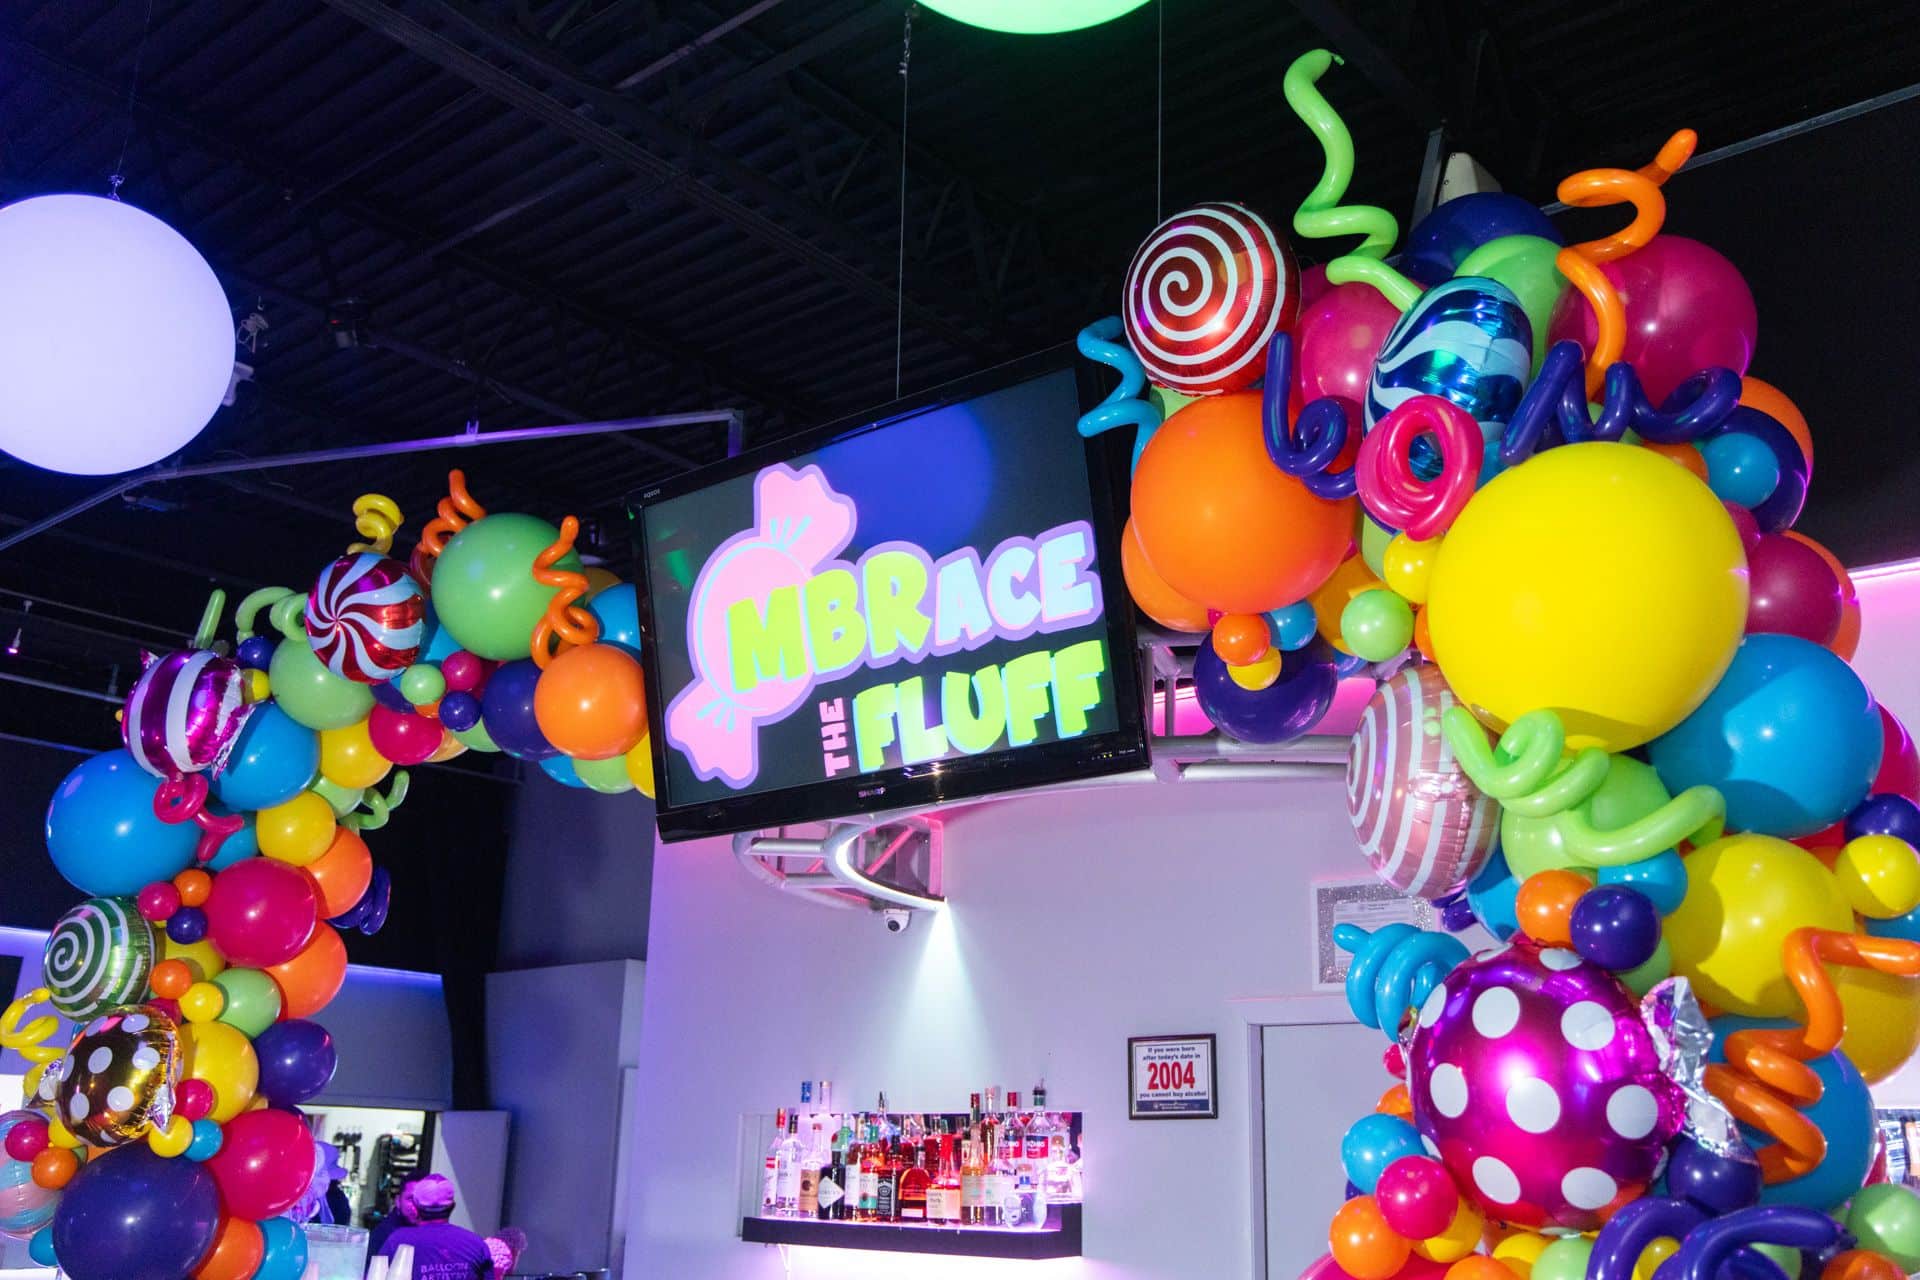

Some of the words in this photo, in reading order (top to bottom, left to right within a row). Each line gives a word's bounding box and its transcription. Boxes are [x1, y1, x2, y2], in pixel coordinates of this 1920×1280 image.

[726, 531, 1095, 695] MBRACE
[819, 697, 851, 778] THE
[852, 640, 1106, 774] FLUFF
[857, 786, 886, 798] SHARP
[1148, 1061, 1195, 1090] 2004
